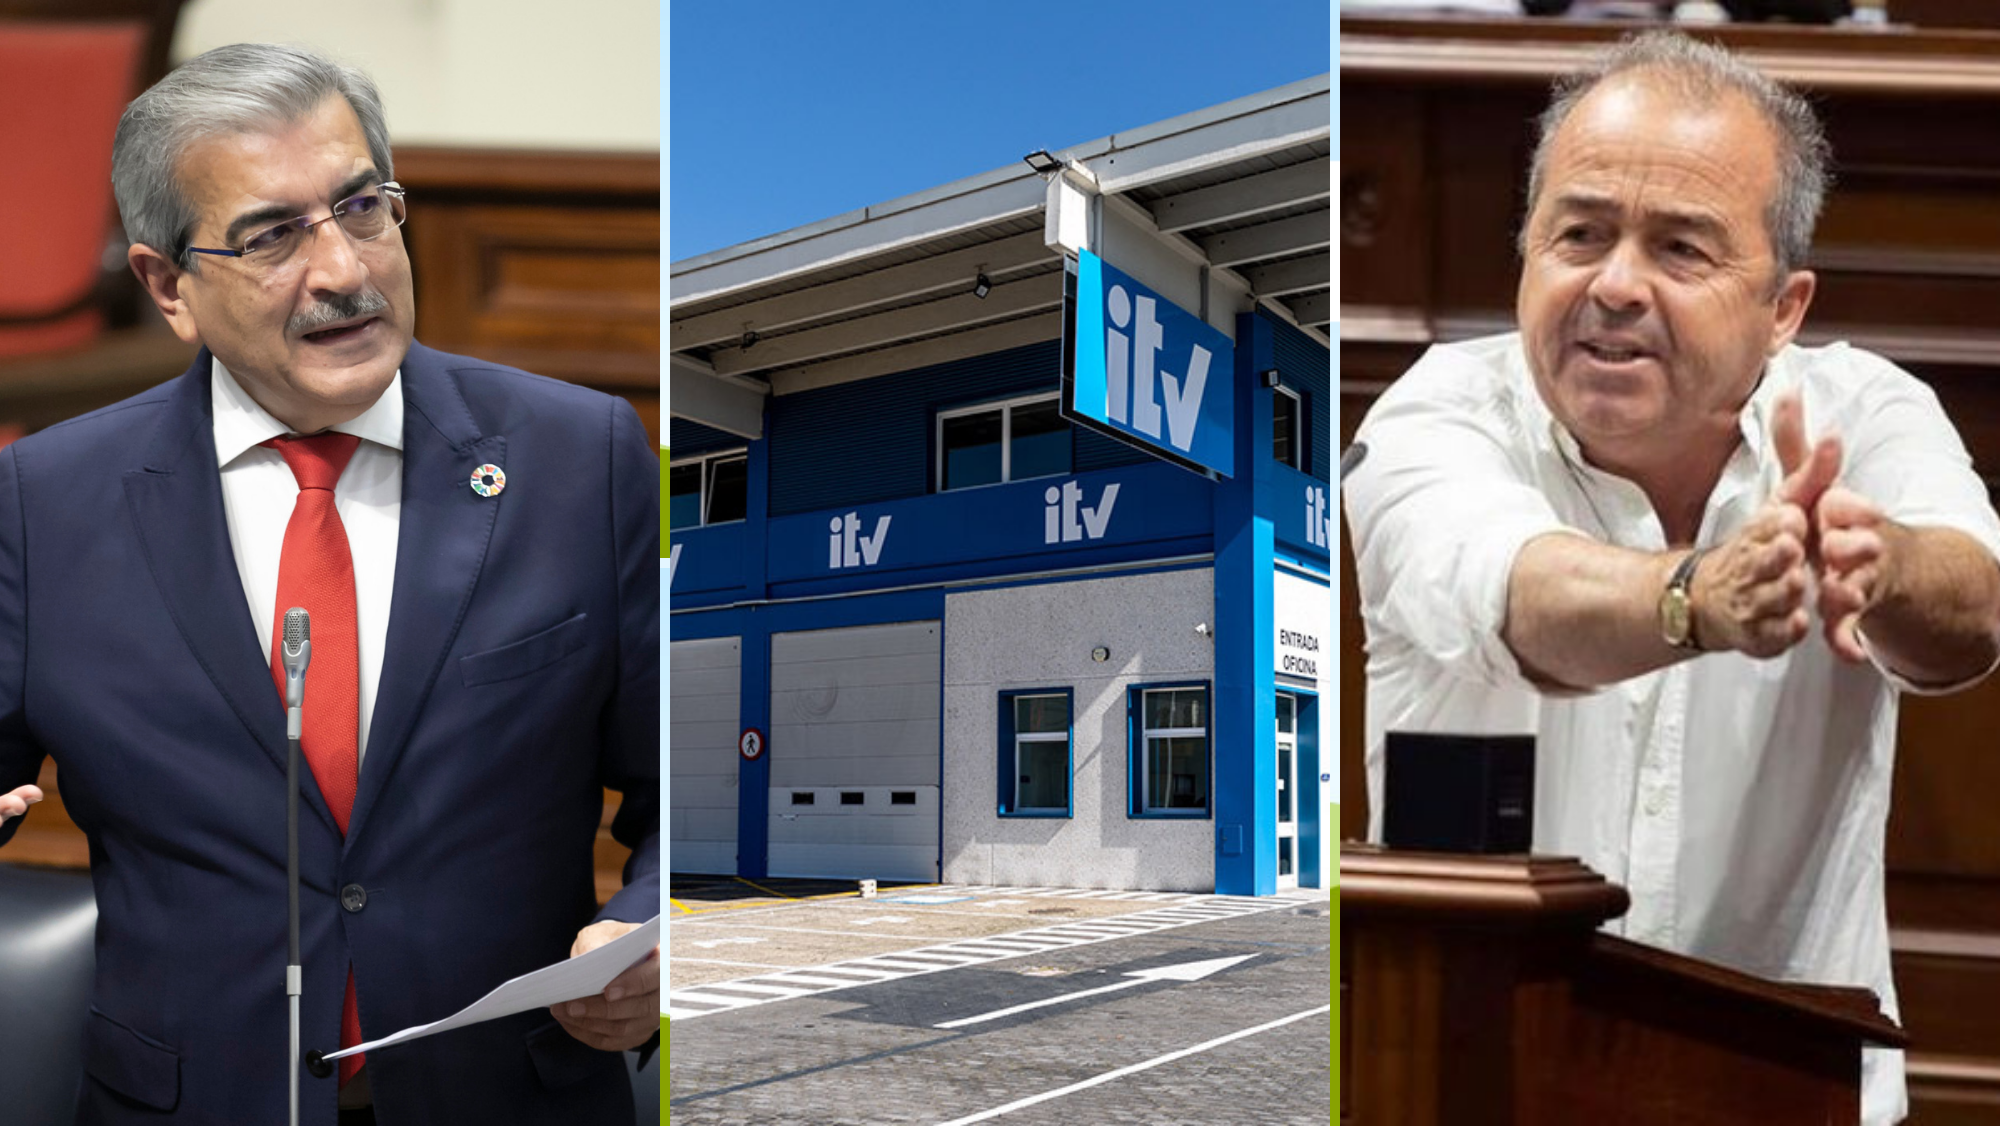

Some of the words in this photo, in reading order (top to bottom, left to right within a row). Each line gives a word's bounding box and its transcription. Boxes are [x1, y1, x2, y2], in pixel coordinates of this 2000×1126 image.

[1108, 284, 1213, 453] itv
[829, 511, 892, 570] itv
[1044, 480, 1121, 545] itv
[1306, 485, 1330, 550] it
[1280, 629, 1320, 653] ENTRADA
[1283, 654, 1318, 676] OFICINA
